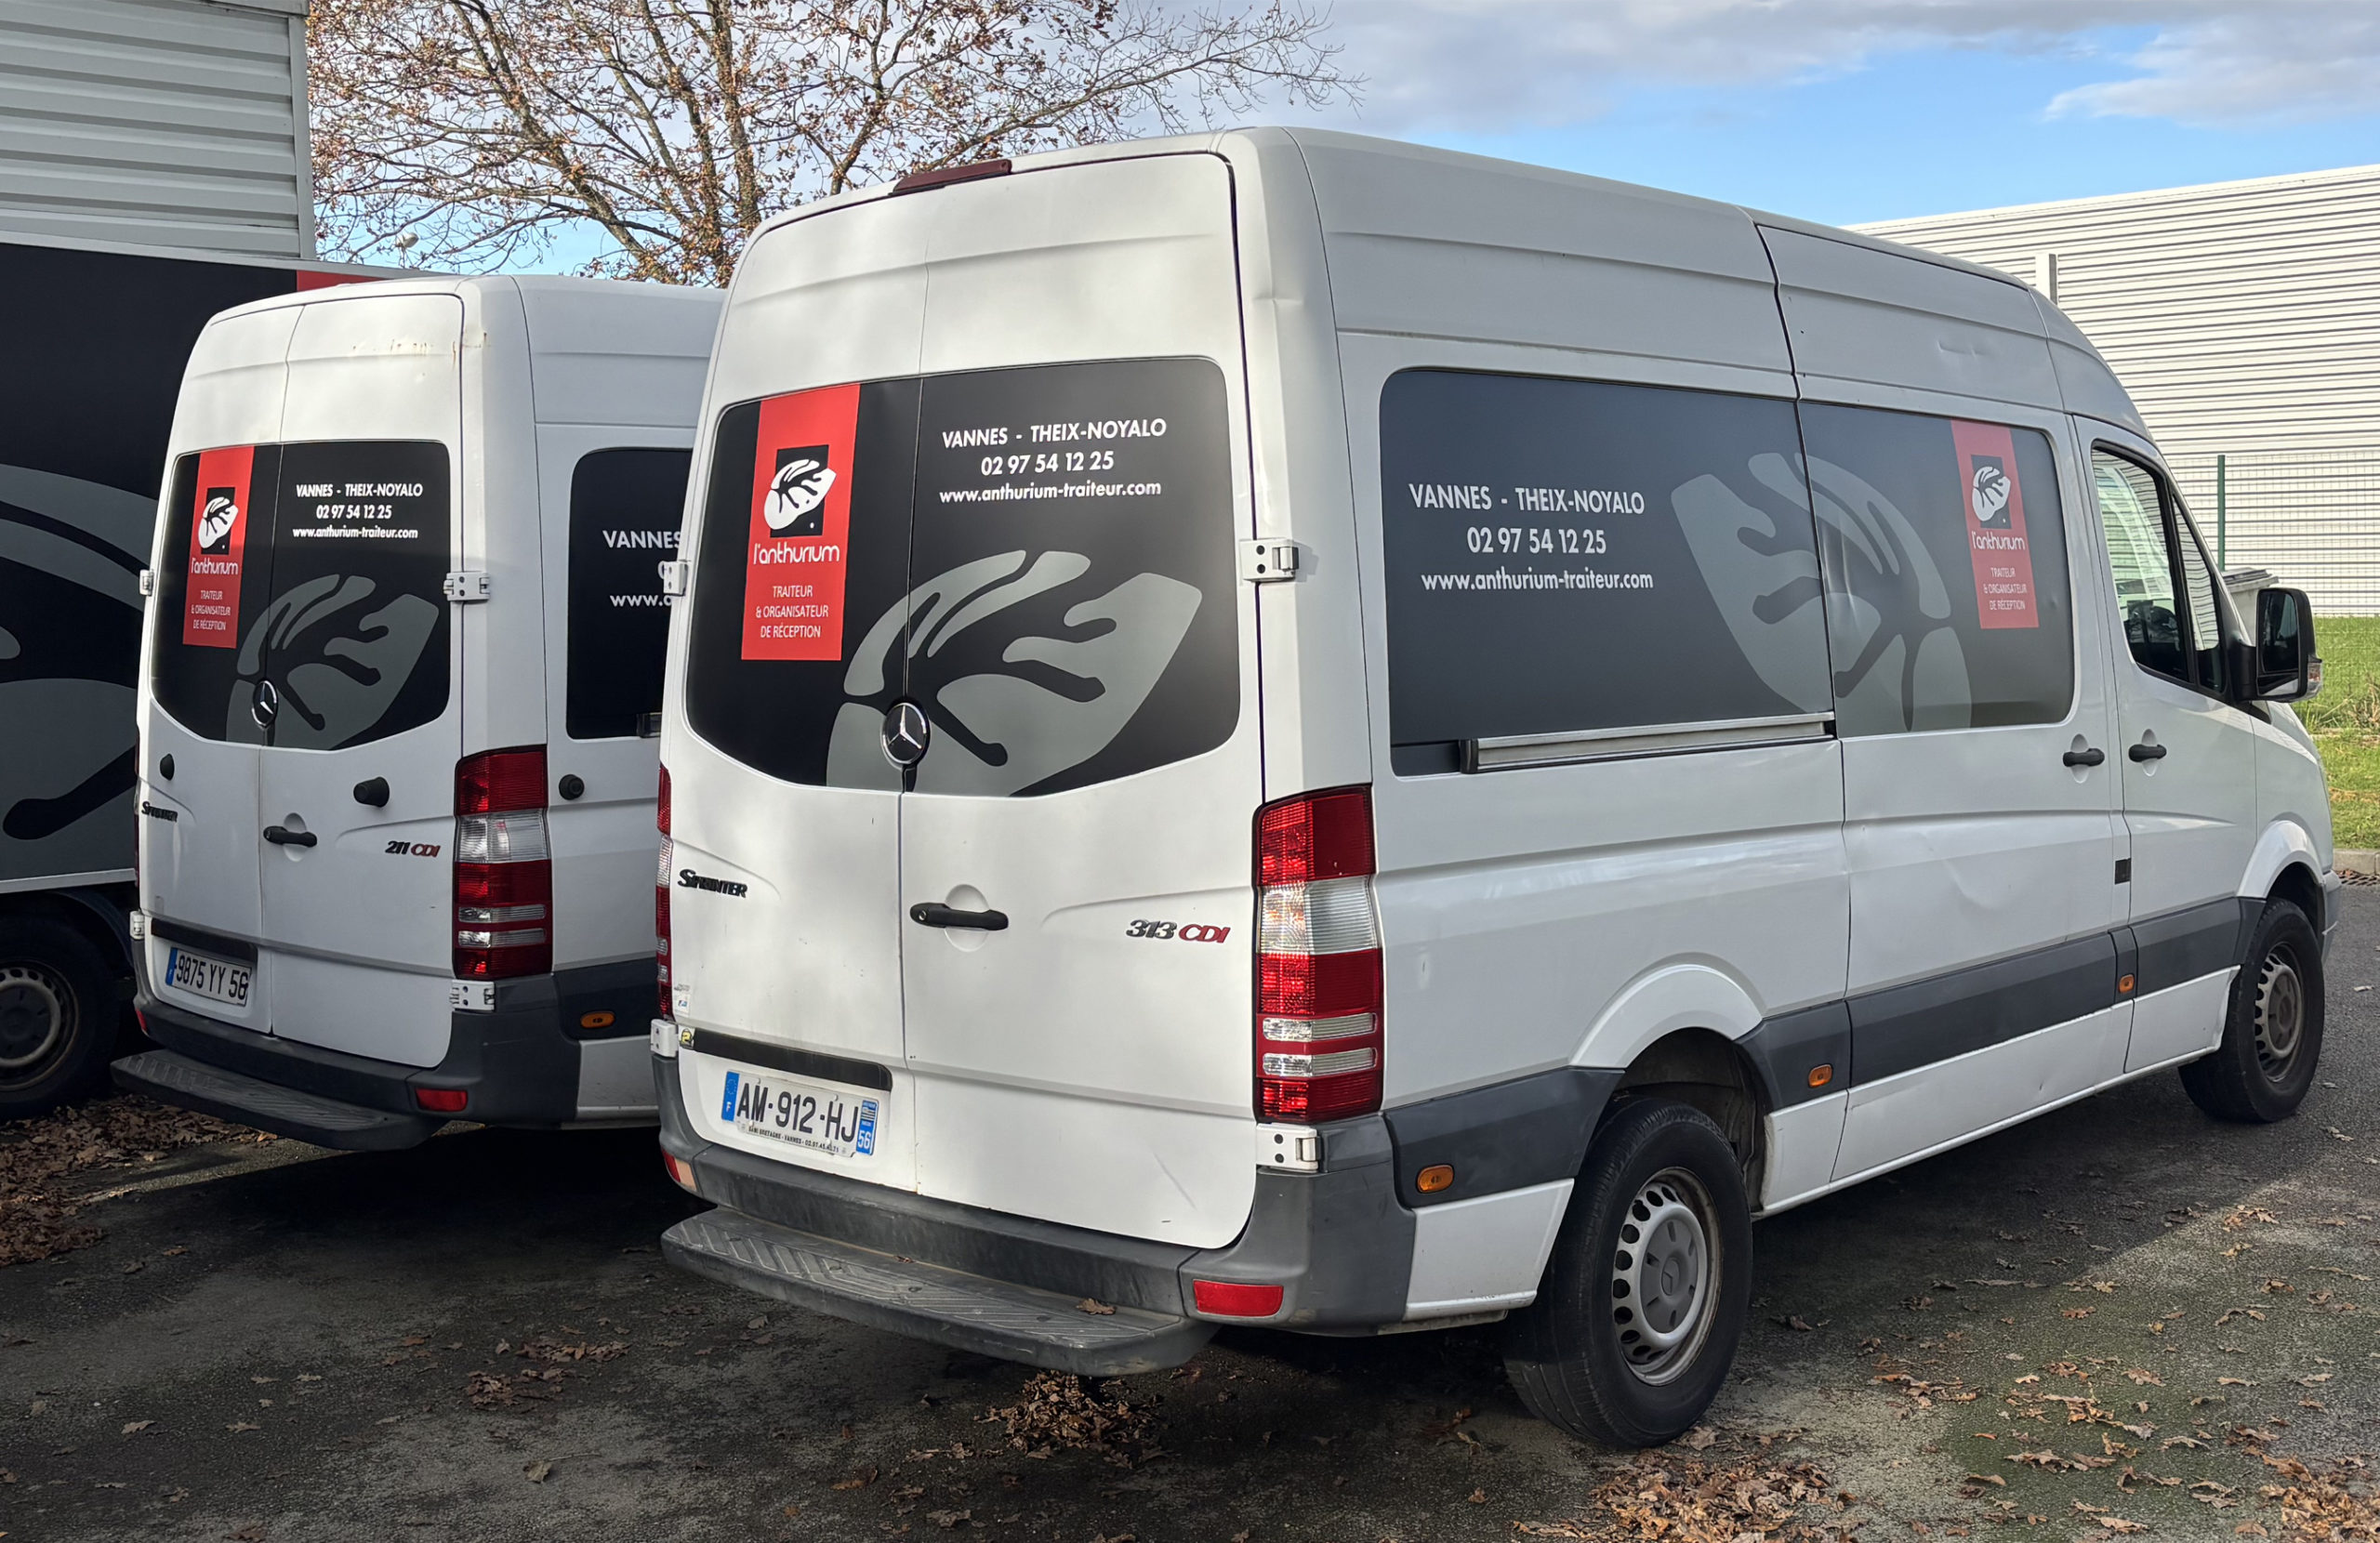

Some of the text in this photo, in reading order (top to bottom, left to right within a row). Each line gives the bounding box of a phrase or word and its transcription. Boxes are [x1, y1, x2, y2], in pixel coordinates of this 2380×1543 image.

[942, 427, 1009, 449] VANNES
[1030, 418, 1168, 442] THEIX-NOYALO
[981, 450, 1115, 476] 02 97 54 12 25
[296, 484, 334, 497] VANNES
[345, 483, 424, 497] THEIX-NOYALO
[939, 480, 1162, 503] www.anthurium-traiteur.com
[1408, 483, 1492, 510] VANNES
[1514, 487, 1645, 514] THEIX-NOYALO
[316, 505, 392, 519] 02 97 54 12 25
[292, 524, 418, 538] www.anthurium-traiteur.com
[1467, 526, 1606, 554] 02 97 54 12 25
[1971, 530, 2026, 550] l'anthurium
[753, 541, 840, 565] l'anthurium
[1421, 565, 1654, 590] www.anthurium-traiteur.com
[1990, 567, 2016, 577] TRAITEUR
[200, 589, 223, 600] TRAITEUR
[773, 585, 813, 598] TRAITEUR
[1989, 583, 2028, 594] ORGANISATEUR
[194, 604, 231, 615] ORGANISATEUR
[756, 604, 829, 618] & ORGANISATEUR
[1990, 600, 1997, 610] DE
[760, 622, 822, 639] DE RÉCEPTION
[385, 840, 442, 858] 211 CDI
[1126, 918, 1232, 943] 313 CDI
[176, 955, 249, 1000] 9875 YY 56
[725, 1101, 733, 1113] F
[857, 1129, 872, 1149] 56
